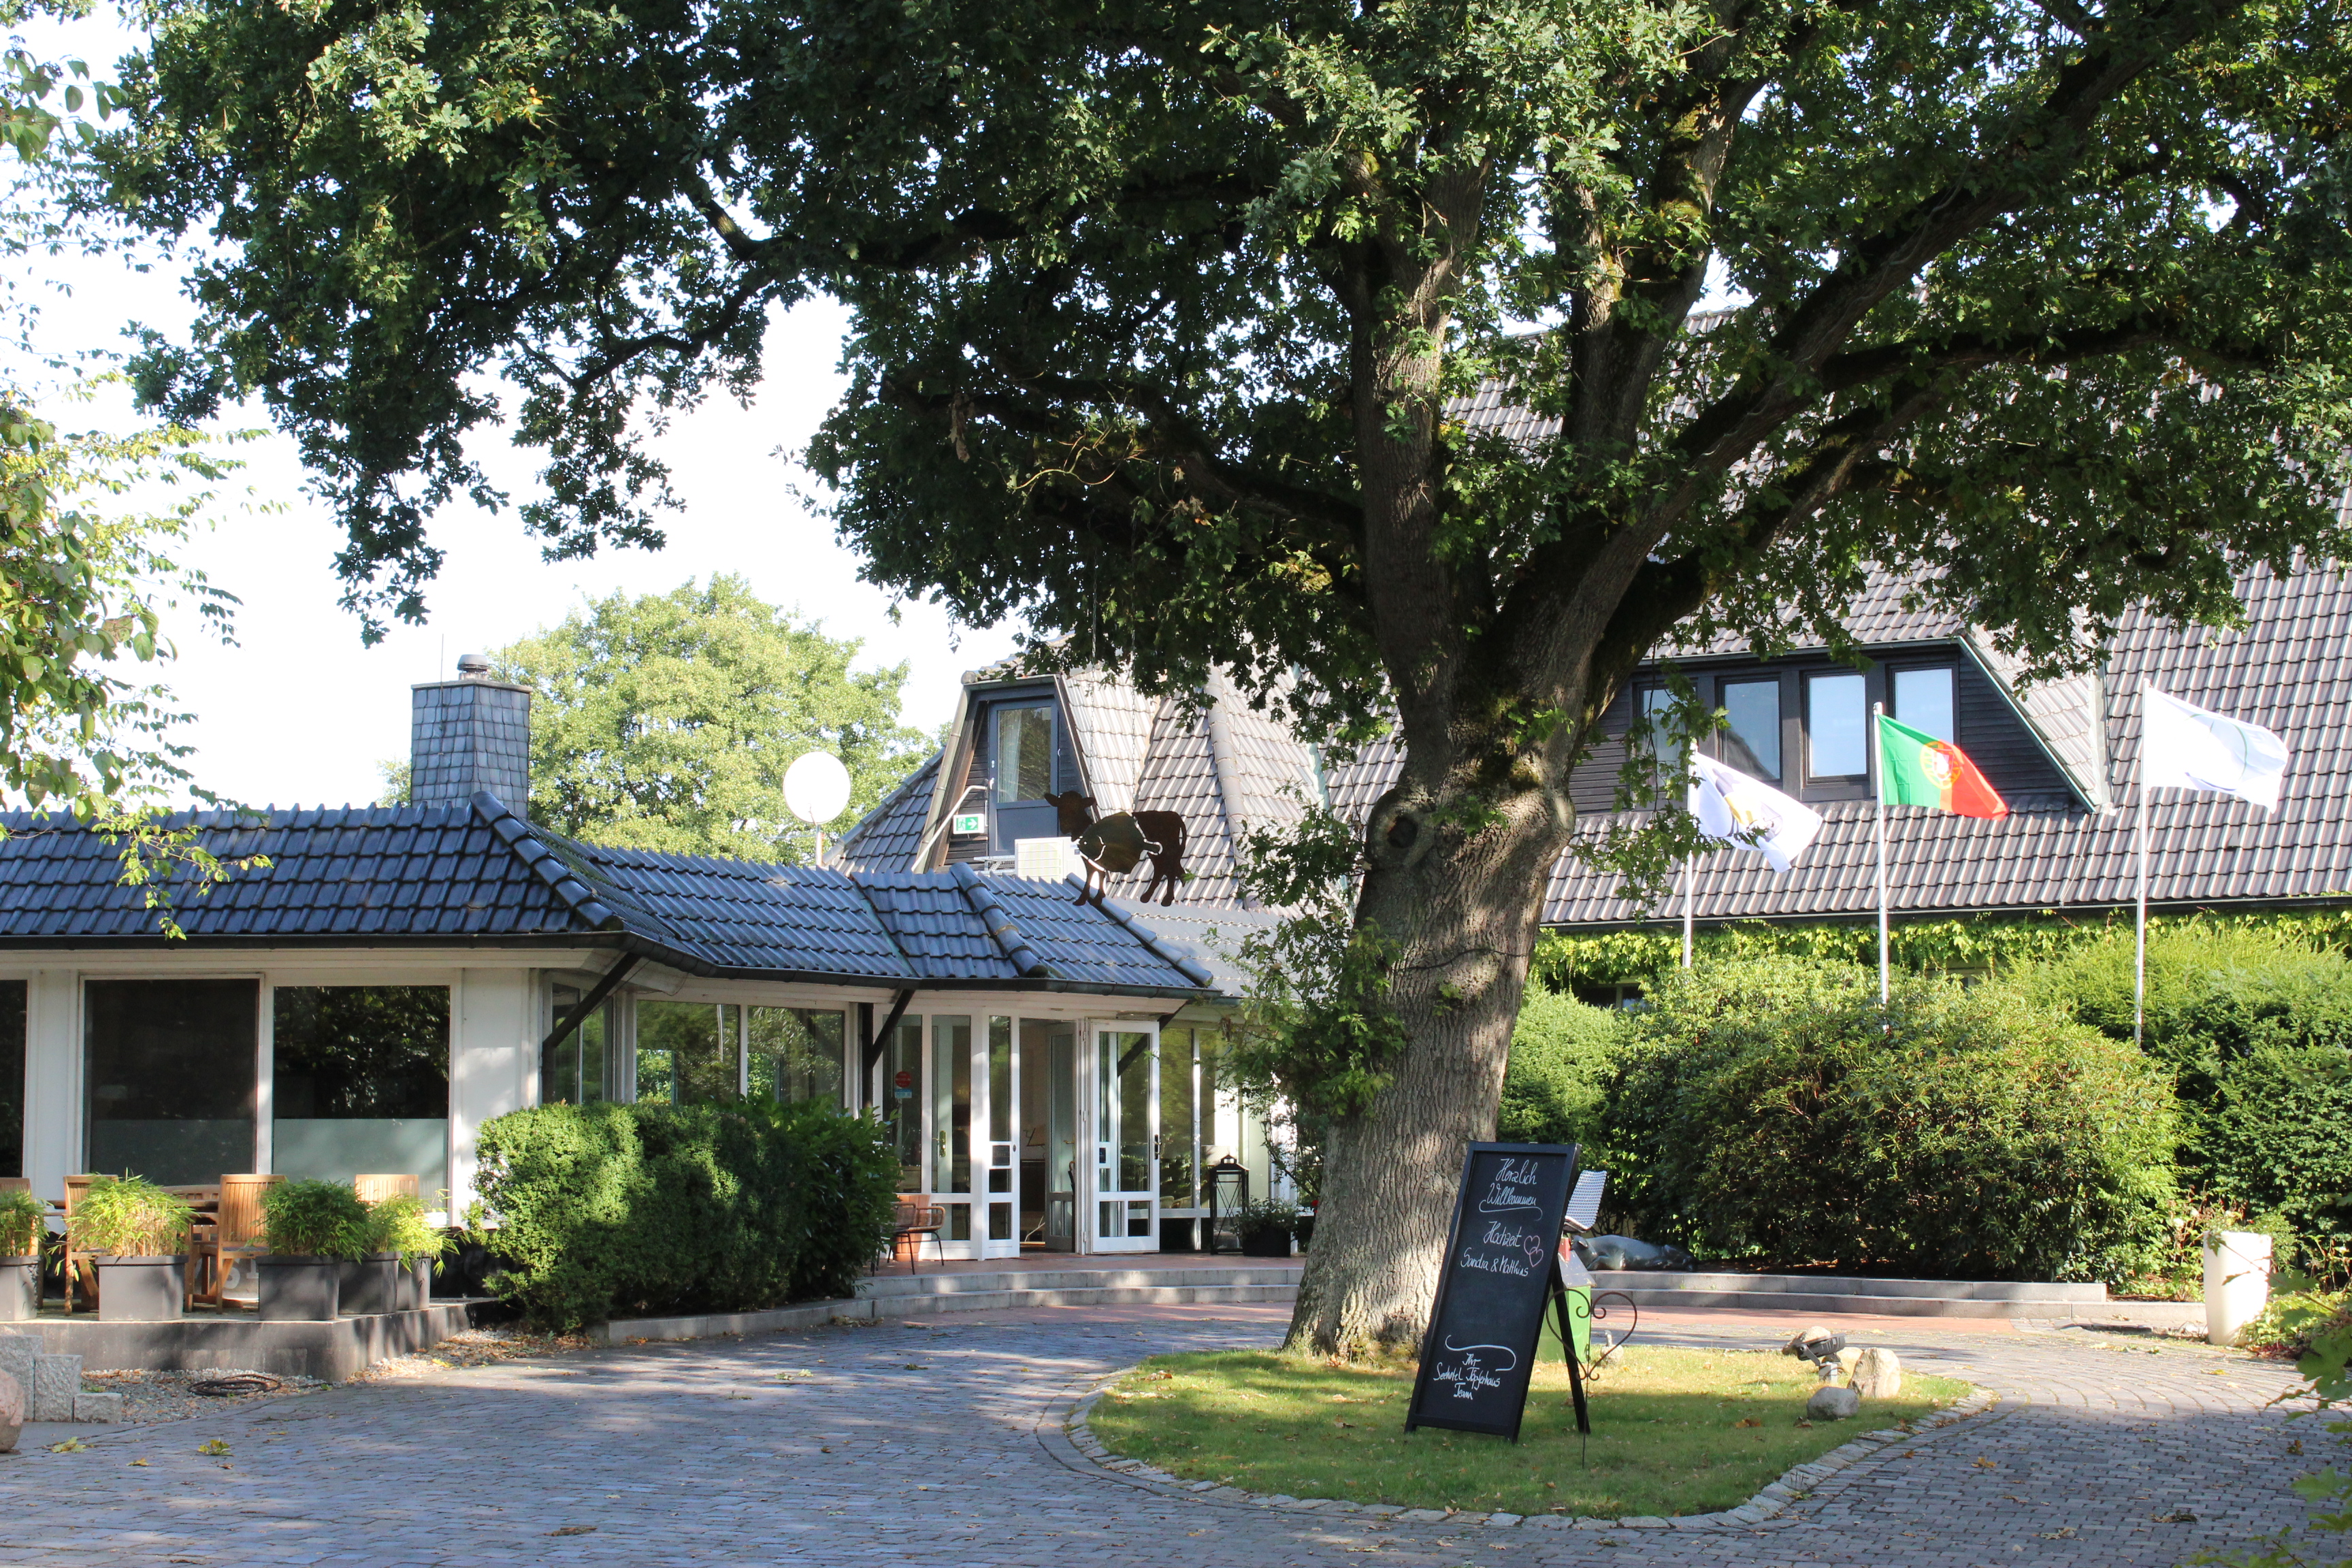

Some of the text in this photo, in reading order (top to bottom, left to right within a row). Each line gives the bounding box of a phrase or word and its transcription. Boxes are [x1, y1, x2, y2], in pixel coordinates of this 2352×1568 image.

[1495, 1158, 1538, 1185] Herzlich
[1486, 1182, 1537, 1205] Willkommen
[1484, 1221, 1522, 1247] Hochzeit
[1460, 1247, 1529, 1277] Sandra & Matthias
[1462, 1352, 1482, 1367] Ihr
[1433, 1362, 1501, 1390] Seehotel Töpferhaus
[1453, 1382, 1473, 1400] Team
